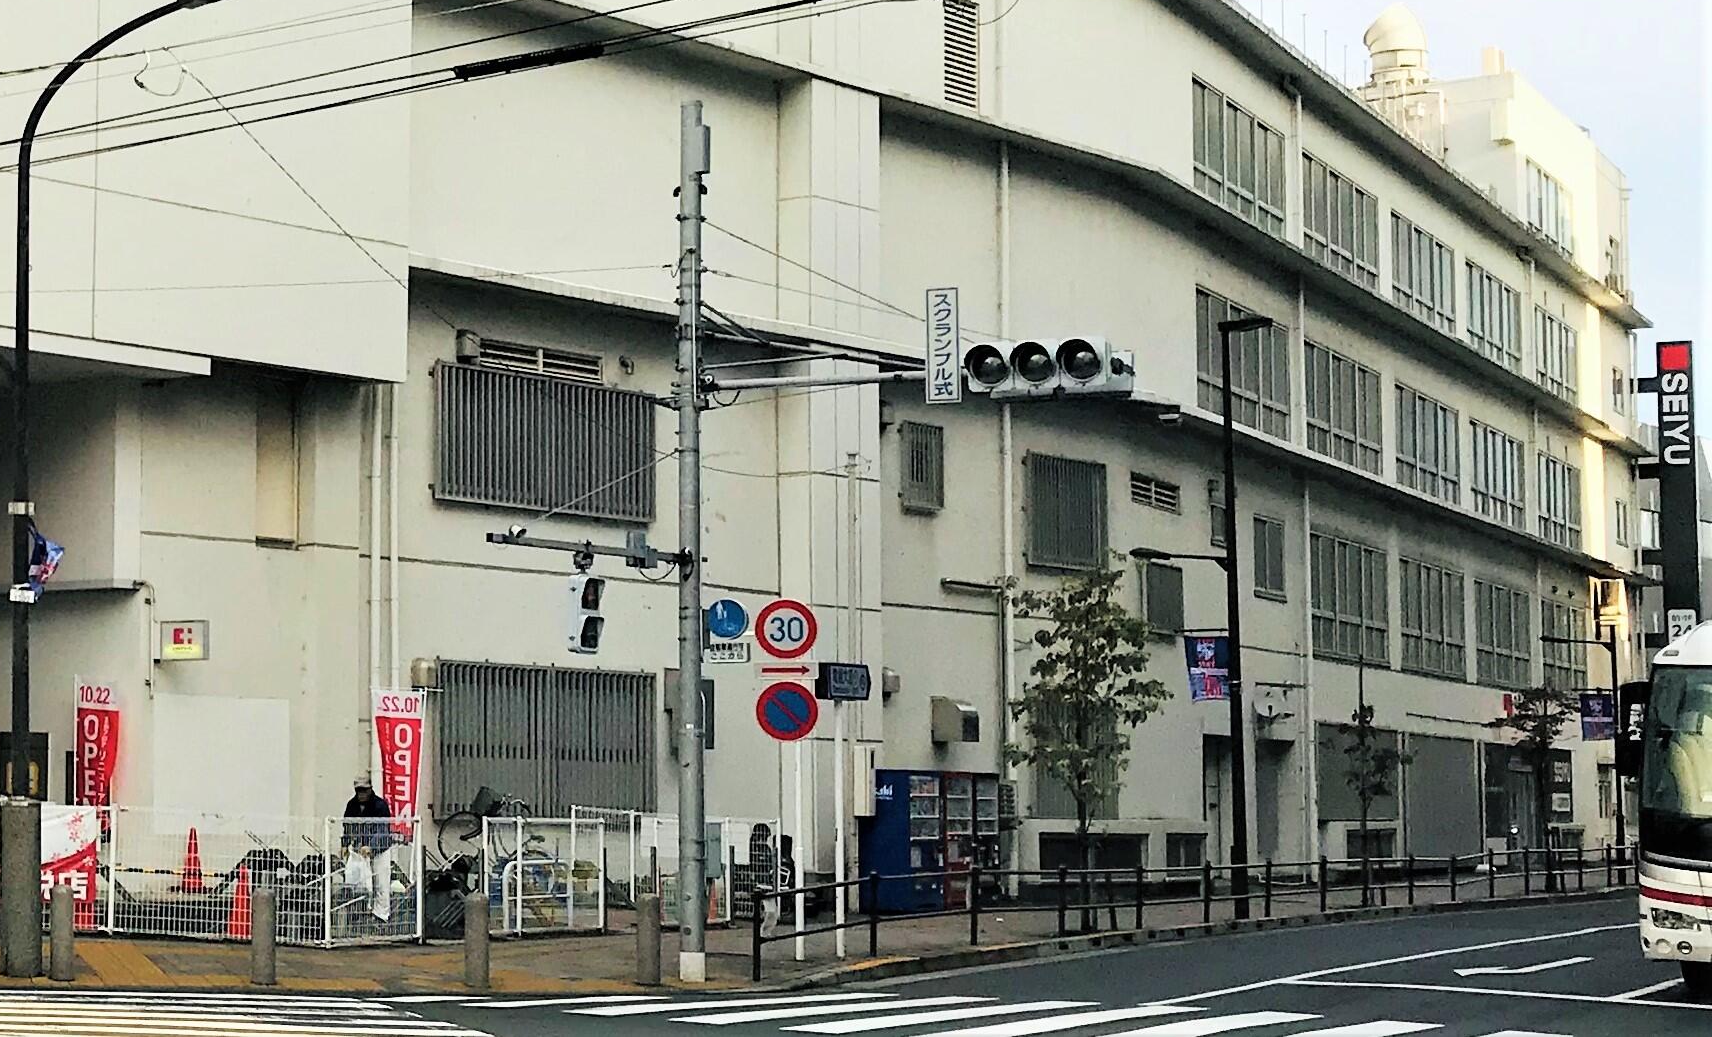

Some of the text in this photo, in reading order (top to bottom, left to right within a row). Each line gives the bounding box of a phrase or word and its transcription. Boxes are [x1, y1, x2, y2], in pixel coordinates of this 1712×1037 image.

[933, 293, 953, 397] スクランブル式
[1661, 372, 1691, 465] SEIYU
[769, 616, 804, 643] 30
[79, 685, 111, 705] 10.22
